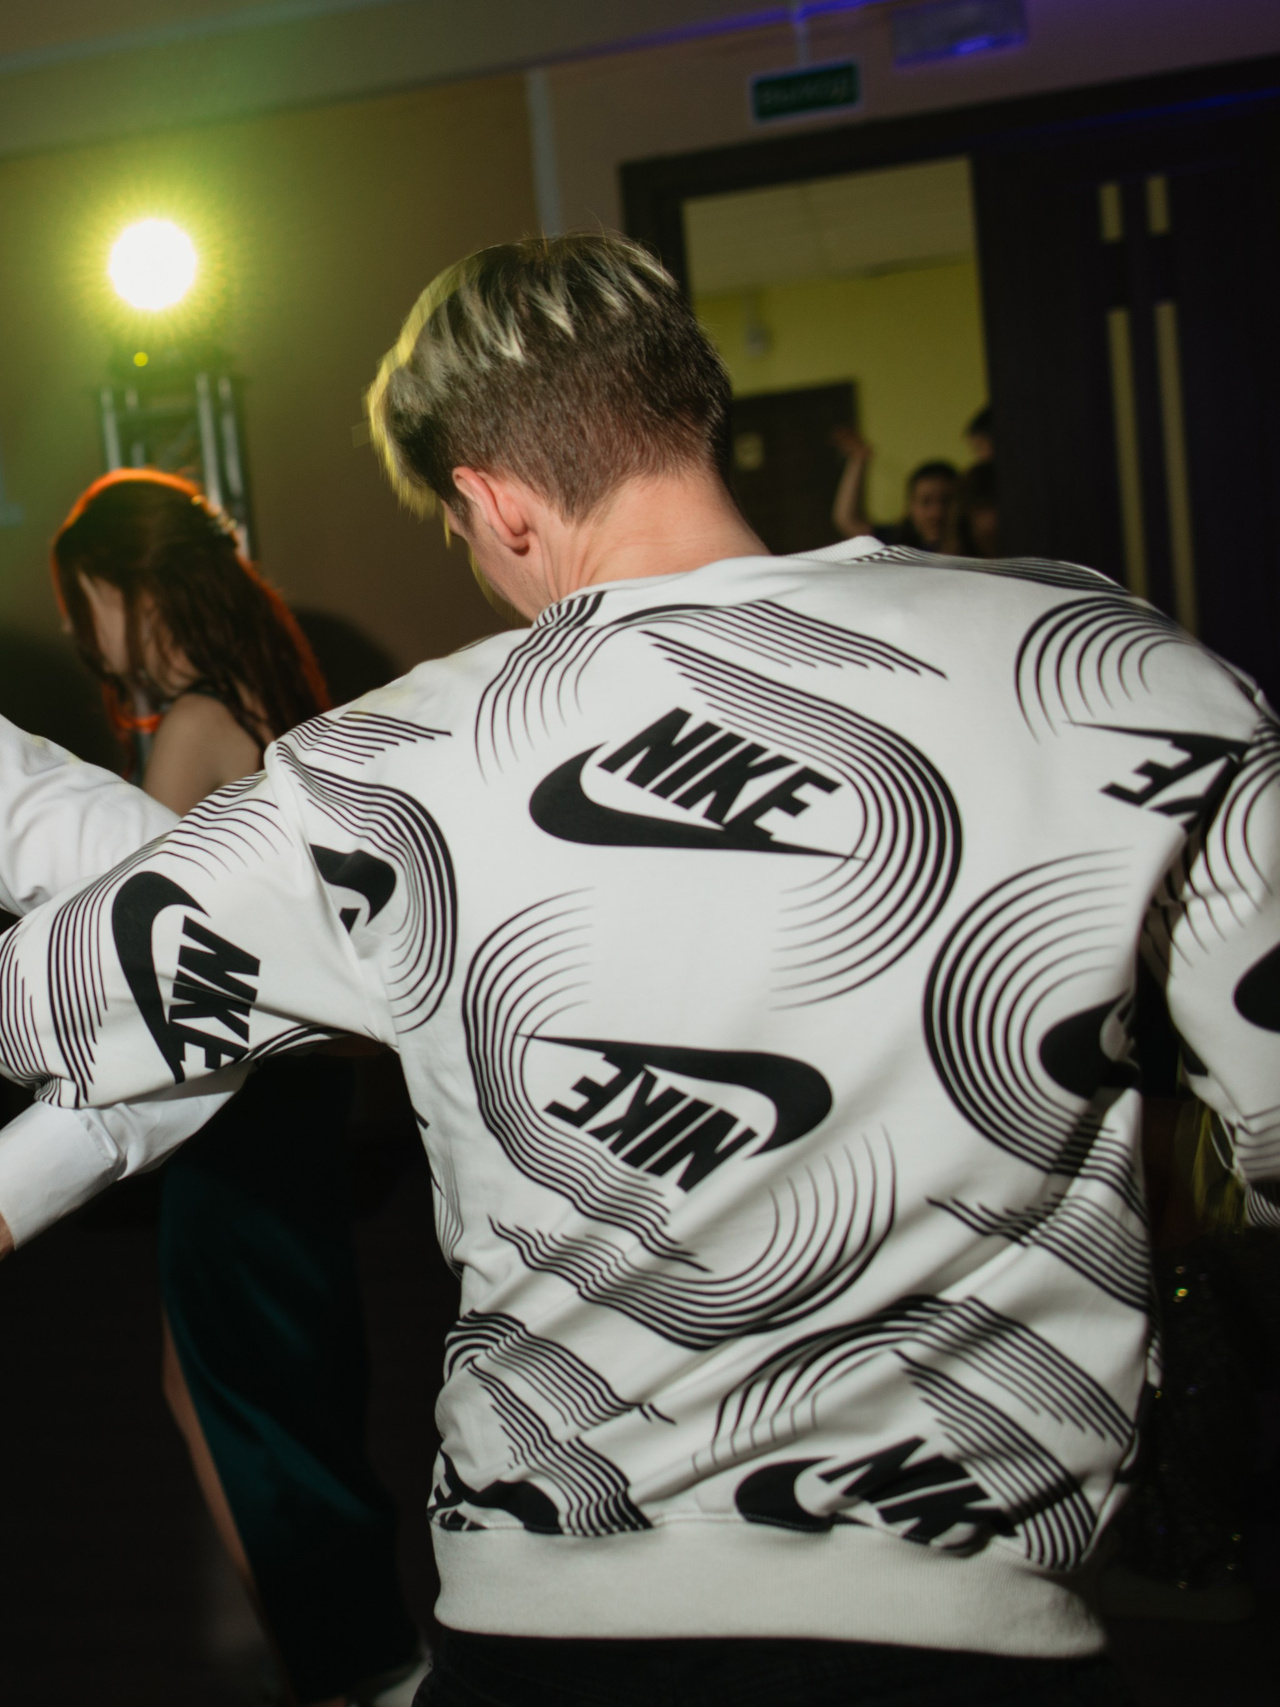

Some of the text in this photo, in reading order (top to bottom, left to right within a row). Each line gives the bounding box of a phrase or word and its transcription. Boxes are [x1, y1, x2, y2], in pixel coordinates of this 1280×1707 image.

[597, 707, 843, 841] NIKE
[1099, 738, 1236, 838] KE
[543, 1050, 758, 1193] NIKE
[818, 1436, 1018, 1547] NIK
